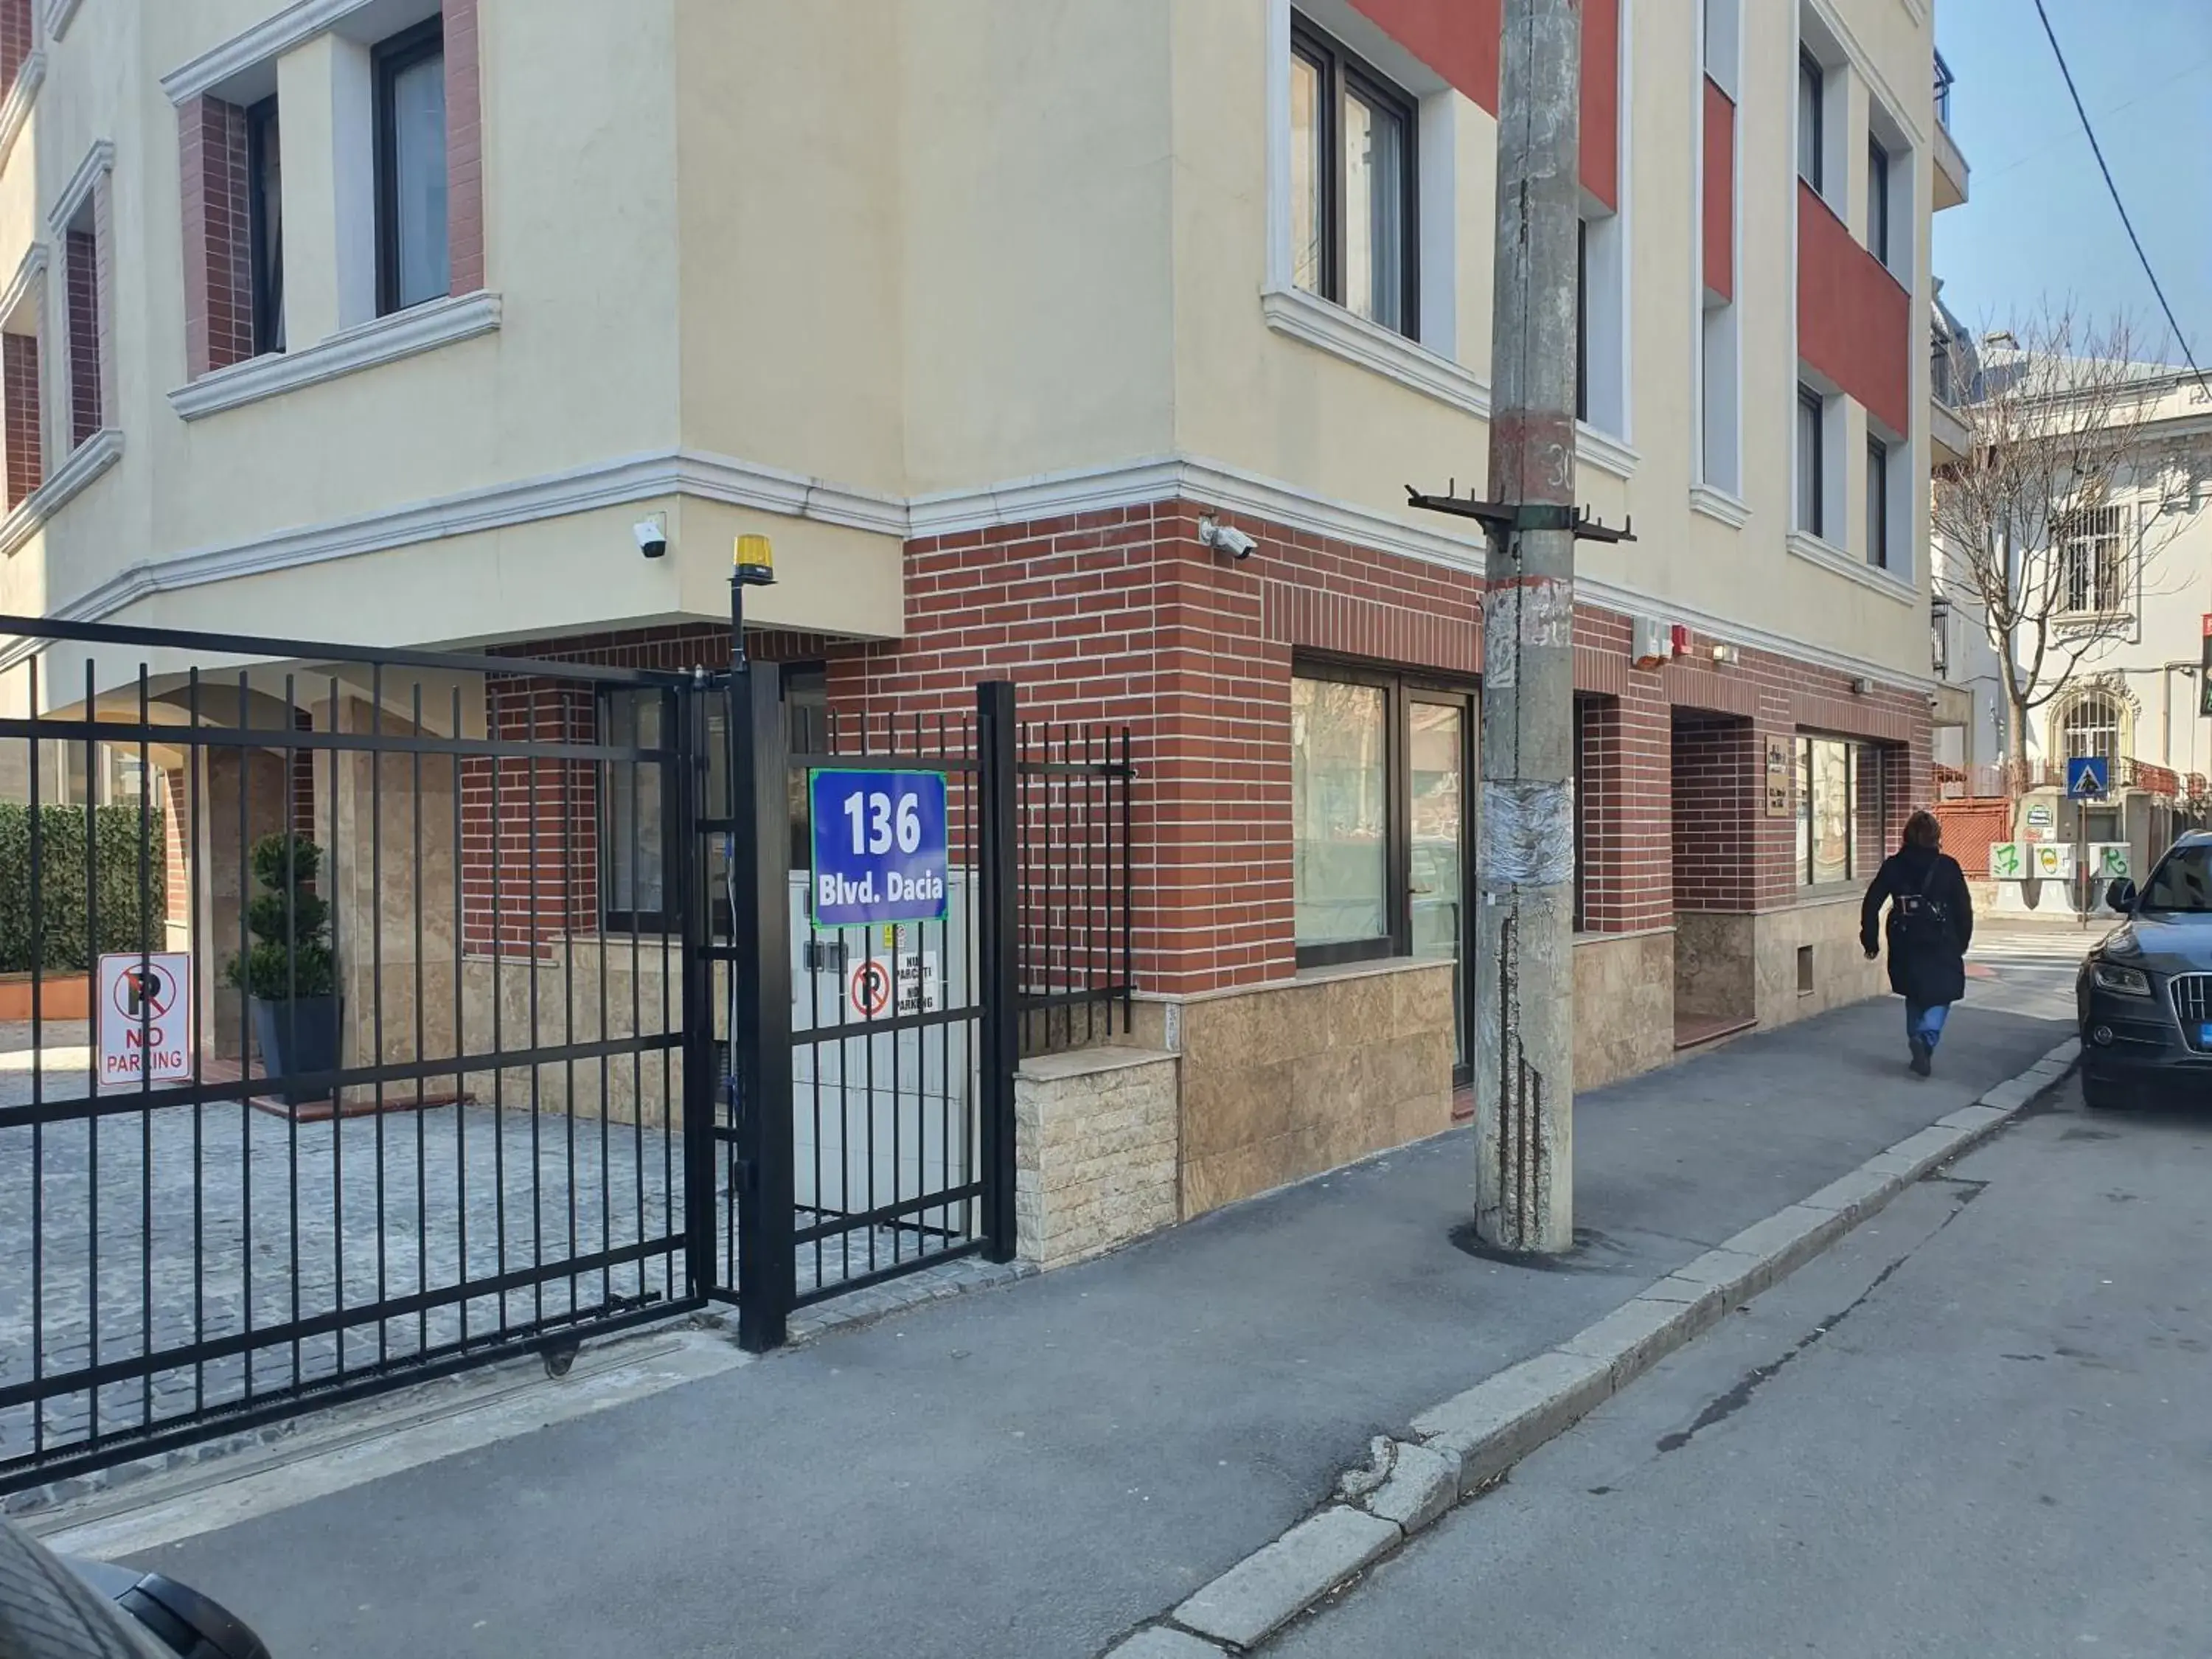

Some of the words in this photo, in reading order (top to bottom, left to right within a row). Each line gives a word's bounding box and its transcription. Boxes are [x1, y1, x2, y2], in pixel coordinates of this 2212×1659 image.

[844, 791, 921, 855] 136
[819, 870, 881, 906] Blvd.
[887, 869, 943, 902] Dacia
[126, 1027, 163, 1048] NO
[107, 1051, 182, 1074] PARING
